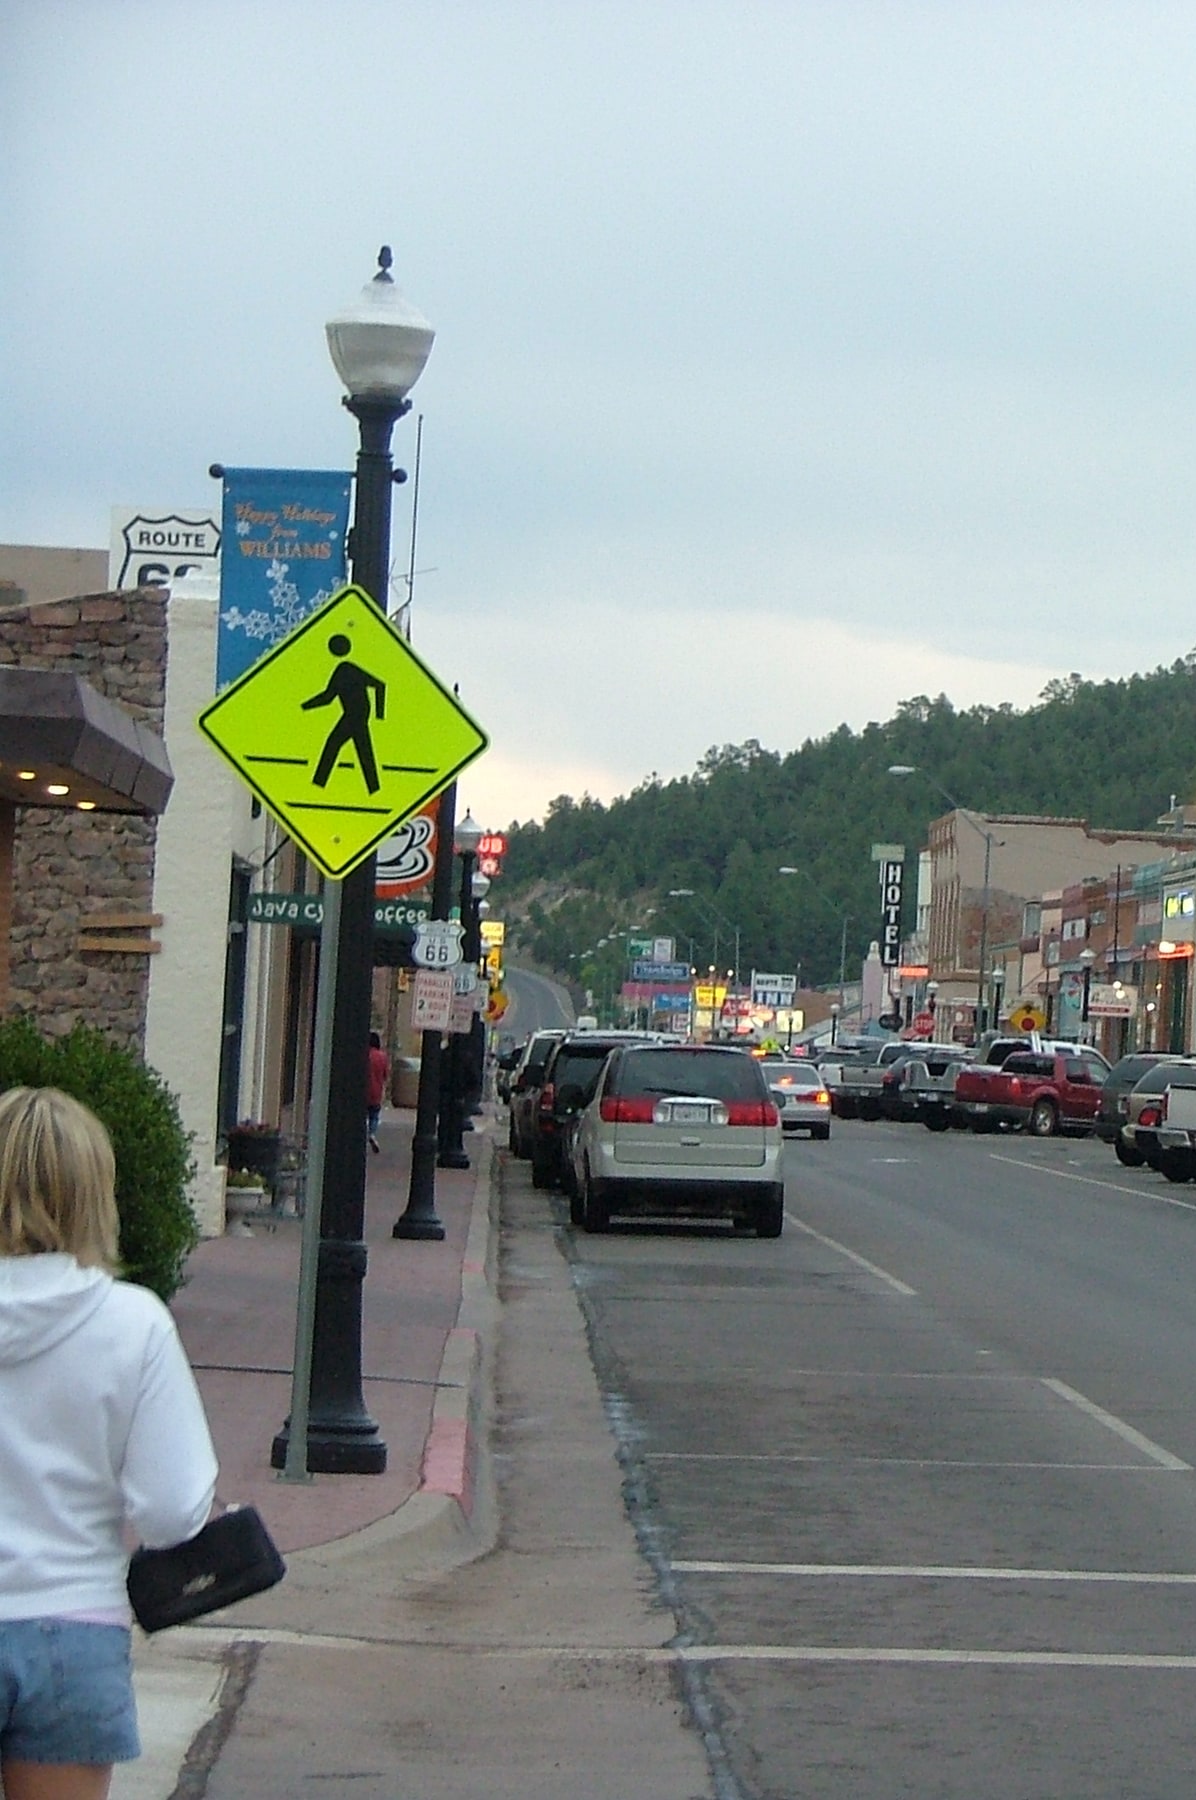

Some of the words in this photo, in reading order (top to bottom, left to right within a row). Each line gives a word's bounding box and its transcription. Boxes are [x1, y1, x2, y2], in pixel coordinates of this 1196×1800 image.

[138, 531, 205, 548] ROUTE
[241, 541, 331, 559] WILLIAMS
[252, 899, 299, 918] Java
[374, 906, 427, 924] offee
[884, 864, 901, 964] HOTEL
[426, 946, 448, 961] 66
[418, 1000, 425, 1010] 2
[914, 1018, 935, 1030] STOP
